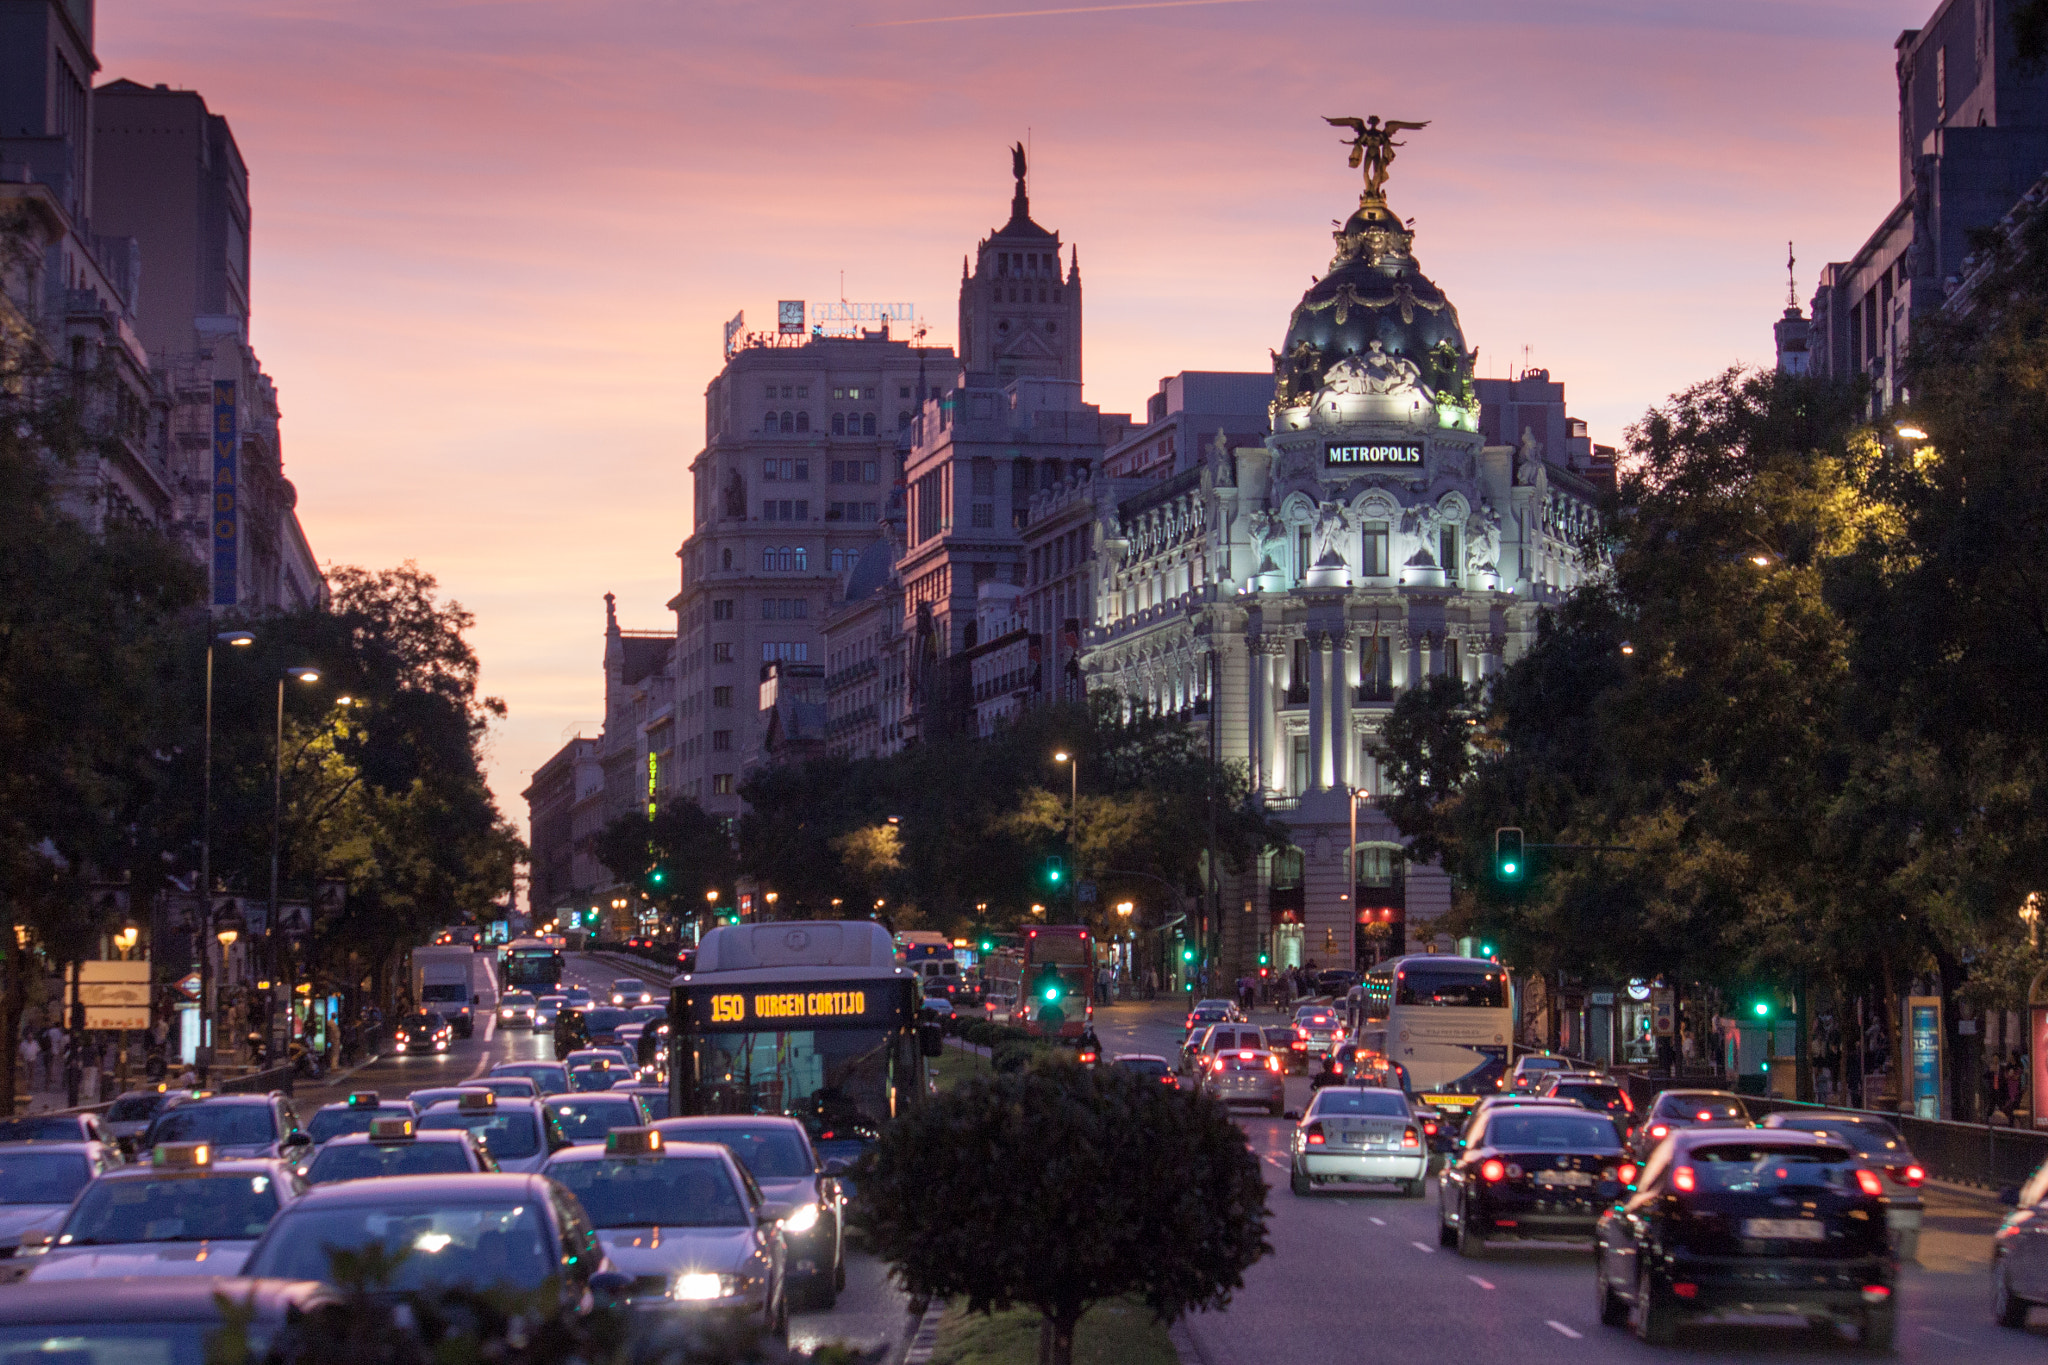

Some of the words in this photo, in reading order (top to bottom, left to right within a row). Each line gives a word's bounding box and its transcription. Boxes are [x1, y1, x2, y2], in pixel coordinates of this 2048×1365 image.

[811, 302, 914, 321] GENERALI
[811, 324, 857, 338] Seguros
[215, 387, 235, 539] NEVADO
[1329, 446, 1420, 462] METROPOLIS
[649, 751, 657, 796] HOTEL
[711, 994, 745, 1022] 150
[755, 993, 805, 1018] VIRGEN
[807, 991, 865, 1016] CORTIJO
[649, 1130, 660, 1150] 1
[194, 1144, 208, 1165] 1
